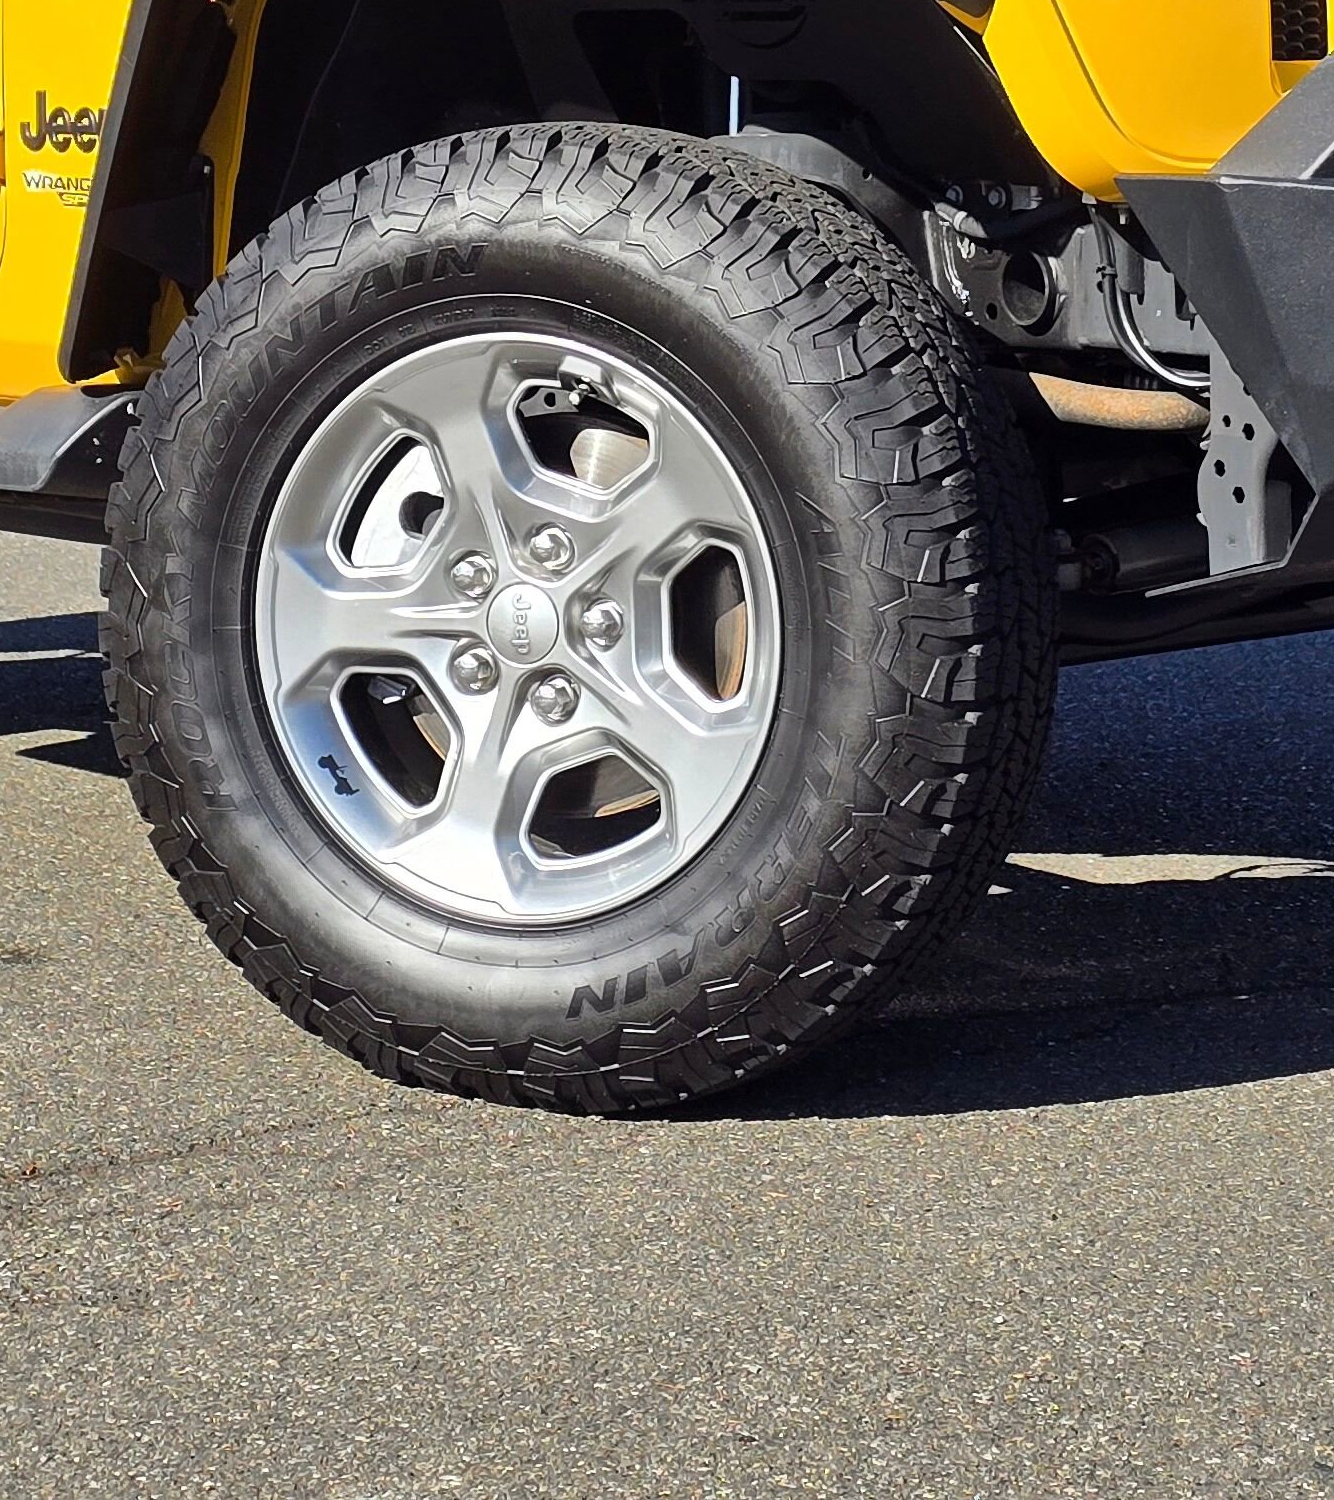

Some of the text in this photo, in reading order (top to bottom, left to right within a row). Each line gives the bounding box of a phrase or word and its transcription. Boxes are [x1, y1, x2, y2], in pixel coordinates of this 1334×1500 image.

[22, 172, 94, 192] WRANG
[175, 242, 490, 531] MOUNTAIN
[510, 592, 532, 656] Jeep
[566, 728, 850, 1021] TERRAIN
